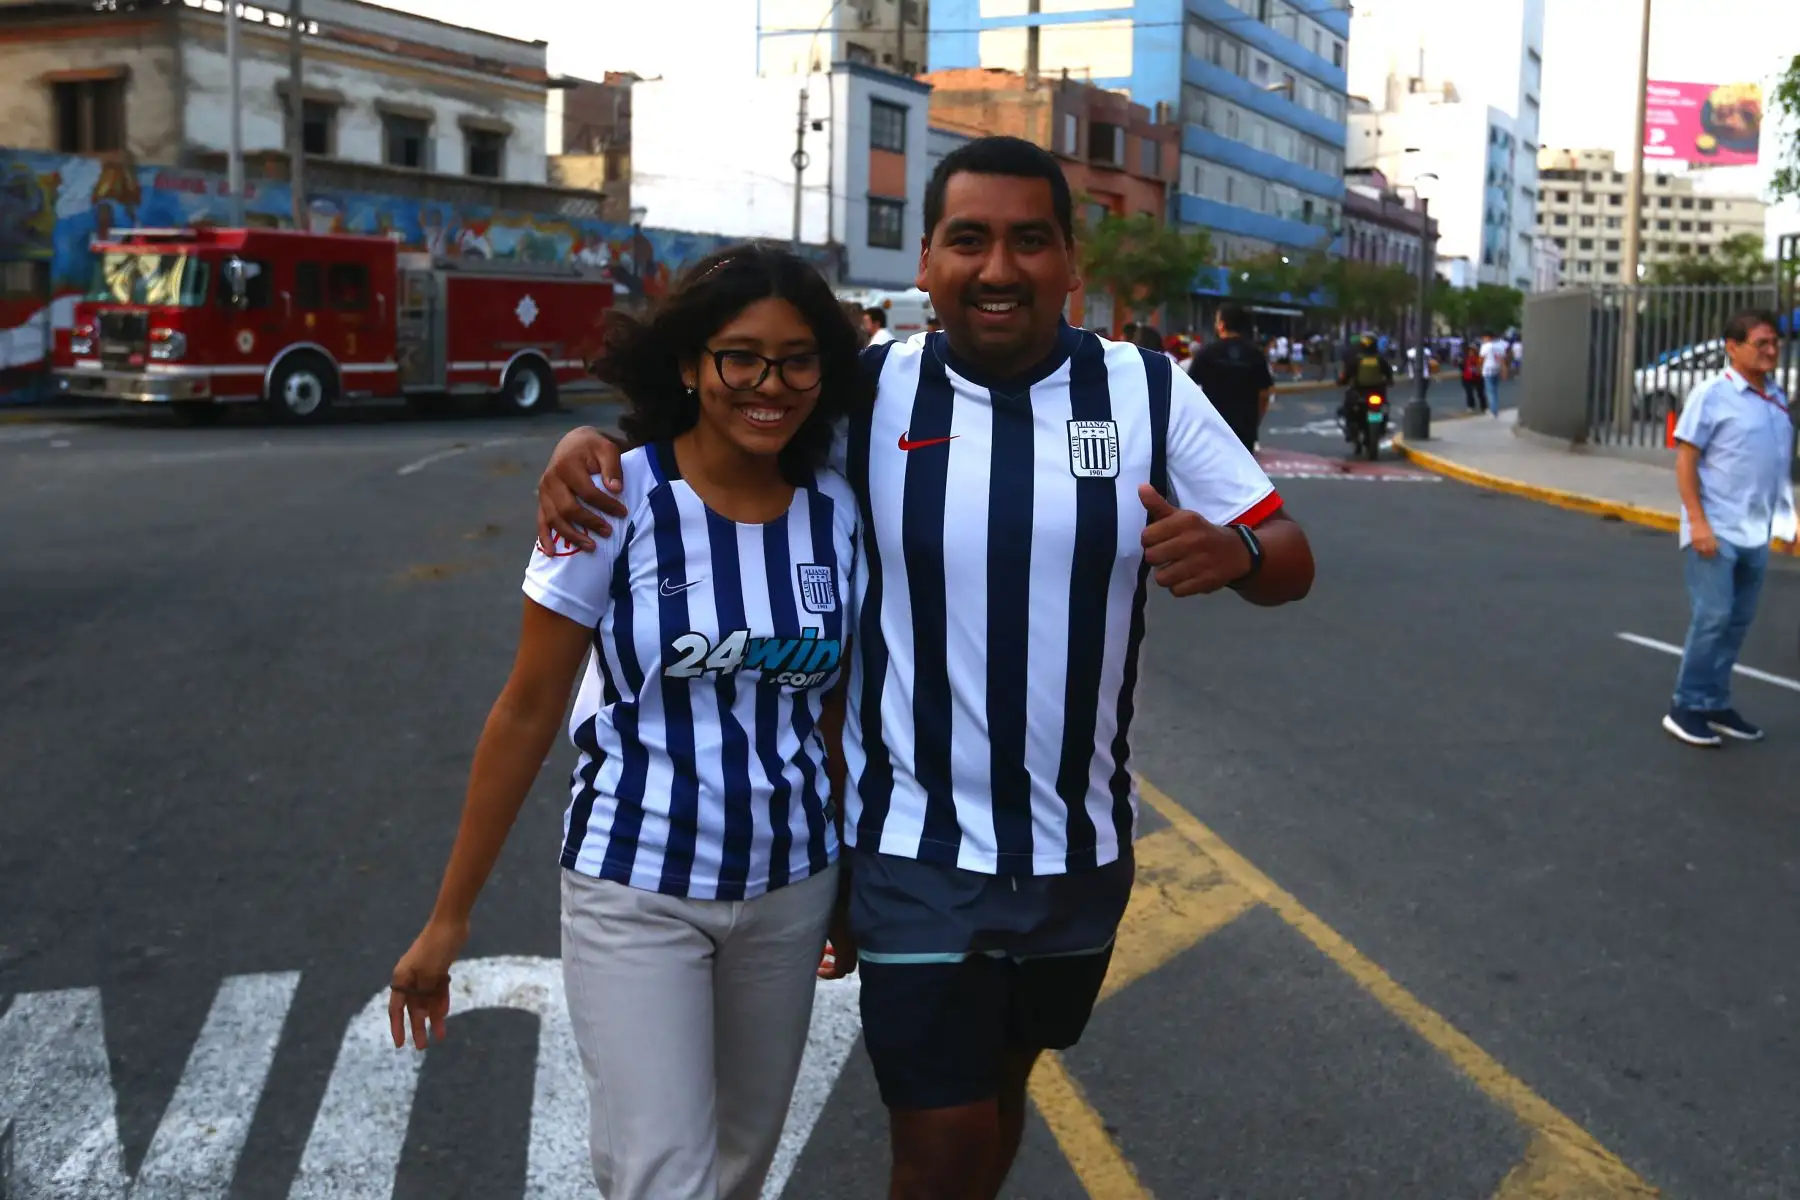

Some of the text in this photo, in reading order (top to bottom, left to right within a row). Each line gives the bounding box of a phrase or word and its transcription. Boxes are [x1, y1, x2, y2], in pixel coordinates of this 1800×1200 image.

[1072, 435, 1080, 459] CLUB
[1109, 436, 1117, 459] LIMA
[664, 627, 841, 678] 24win
[769, 671, 826, 687] .com
